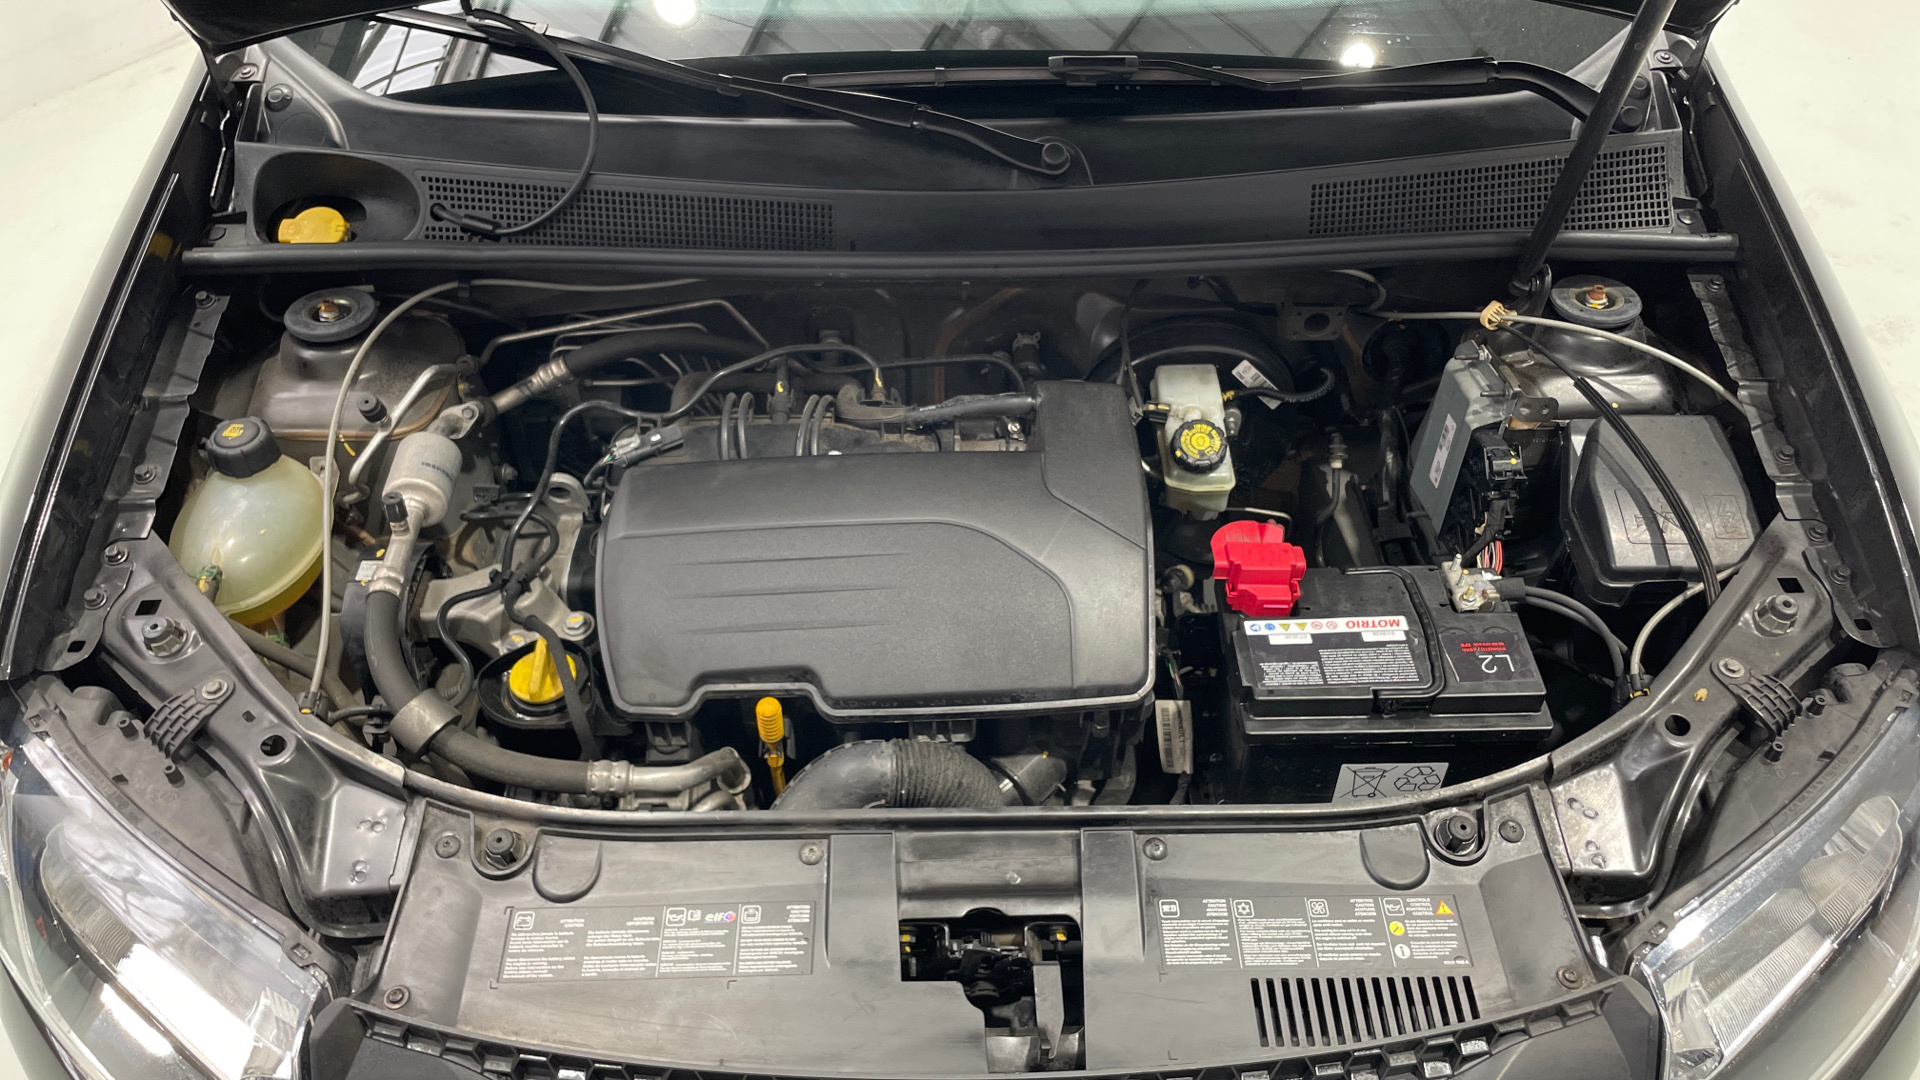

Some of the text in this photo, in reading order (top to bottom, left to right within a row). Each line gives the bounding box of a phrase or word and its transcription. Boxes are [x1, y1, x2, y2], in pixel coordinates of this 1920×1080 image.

[1346, 619, 1400, 629] MOTRIO
[1478, 654, 1515, 674] L2
[705, 911, 726, 921] elf
